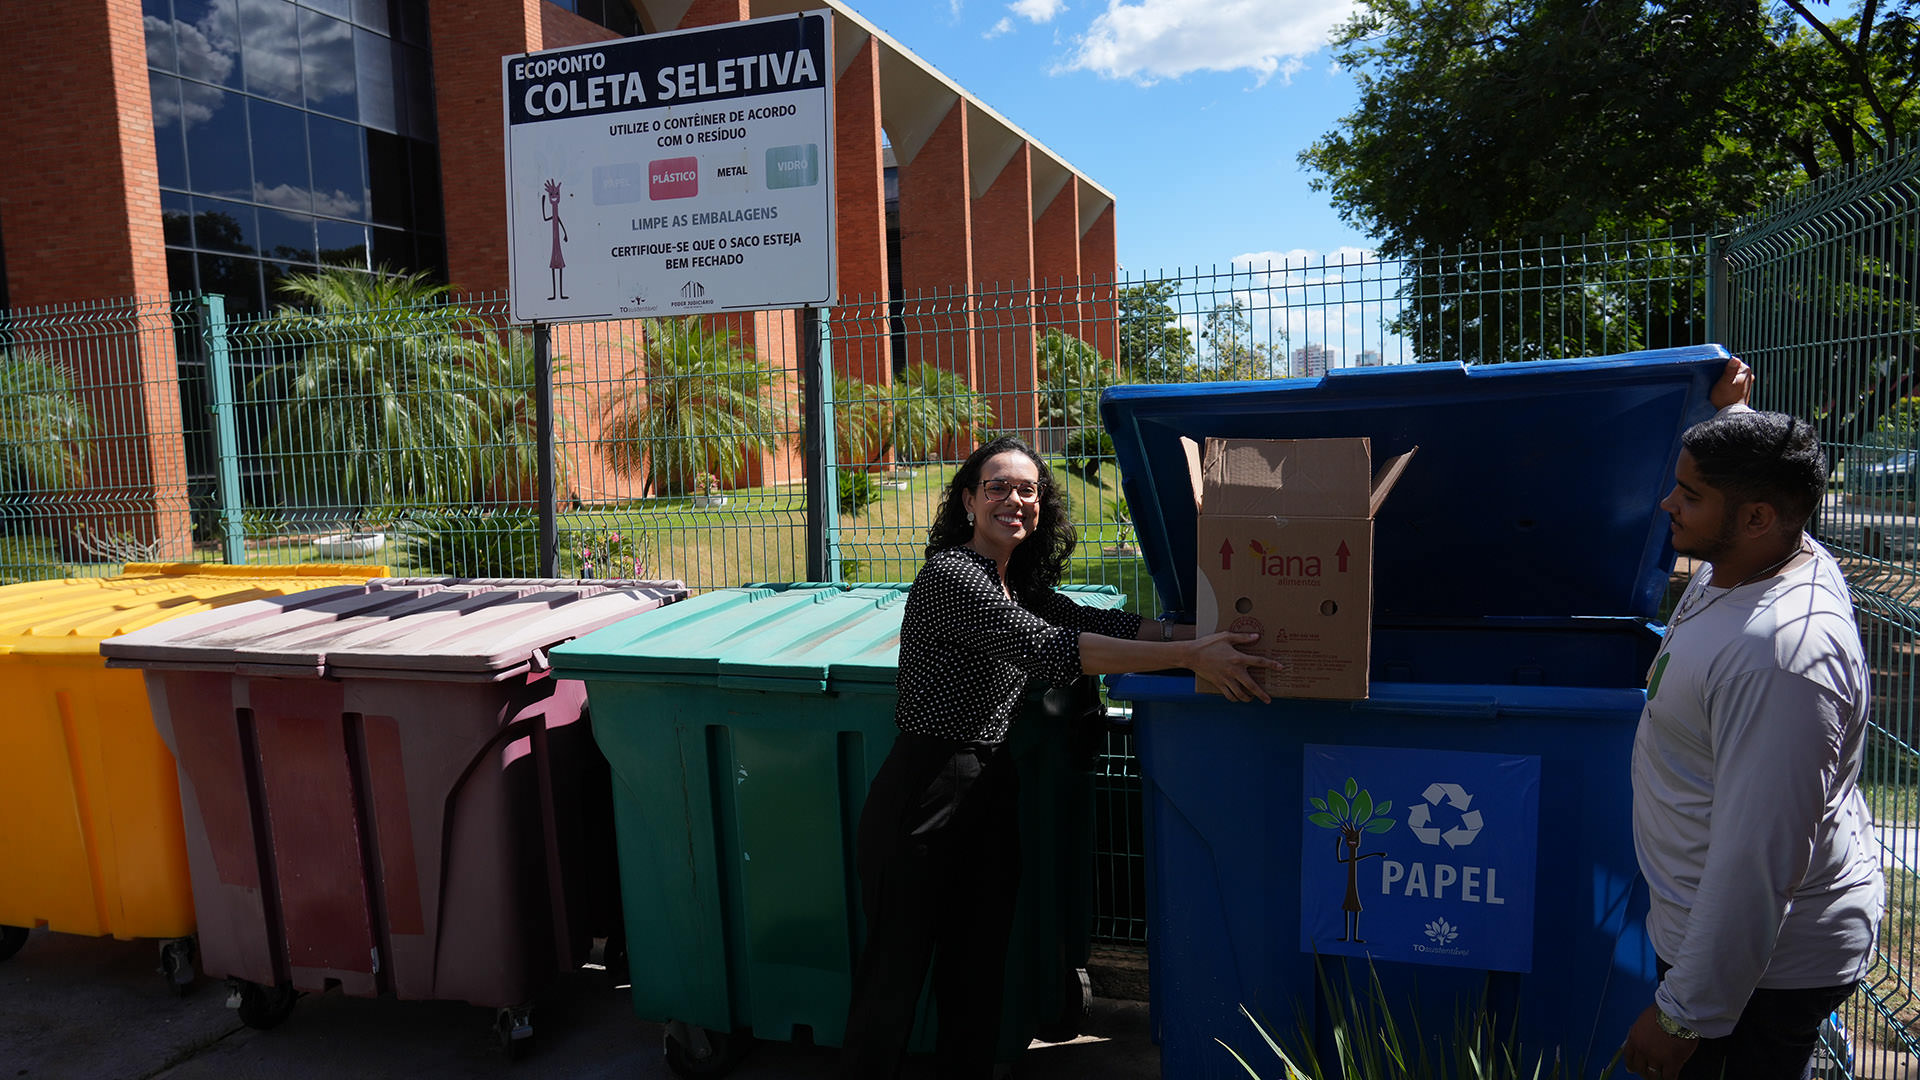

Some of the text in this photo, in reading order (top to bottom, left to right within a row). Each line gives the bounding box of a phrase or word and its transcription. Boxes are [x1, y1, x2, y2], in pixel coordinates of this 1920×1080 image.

[515, 52, 606, 80] ECOPONTO
[524, 49, 818, 116] COLETA SELETIVA
[609, 104, 797, 136] UTILIZE O CONTÊINER DE ACORDO
[657, 127, 746, 148] COM O RESÍDUO
[652, 170, 696, 185] PLÁSTICO
[717, 166, 748, 178] METAL
[777, 160, 808, 172] VIDRO
[632, 206, 778, 231] LIMPE AS EMBALAGENS
[611, 233, 801, 258] CERTIFIQUE-SE QUE O SACO ESTEJA
[665, 254, 744, 270] BEM FECHADO
[1261, 552, 1321, 577] iana
[1278, 578, 1321, 587] alimentos
[1382, 860, 1505, 905] PAPEL
